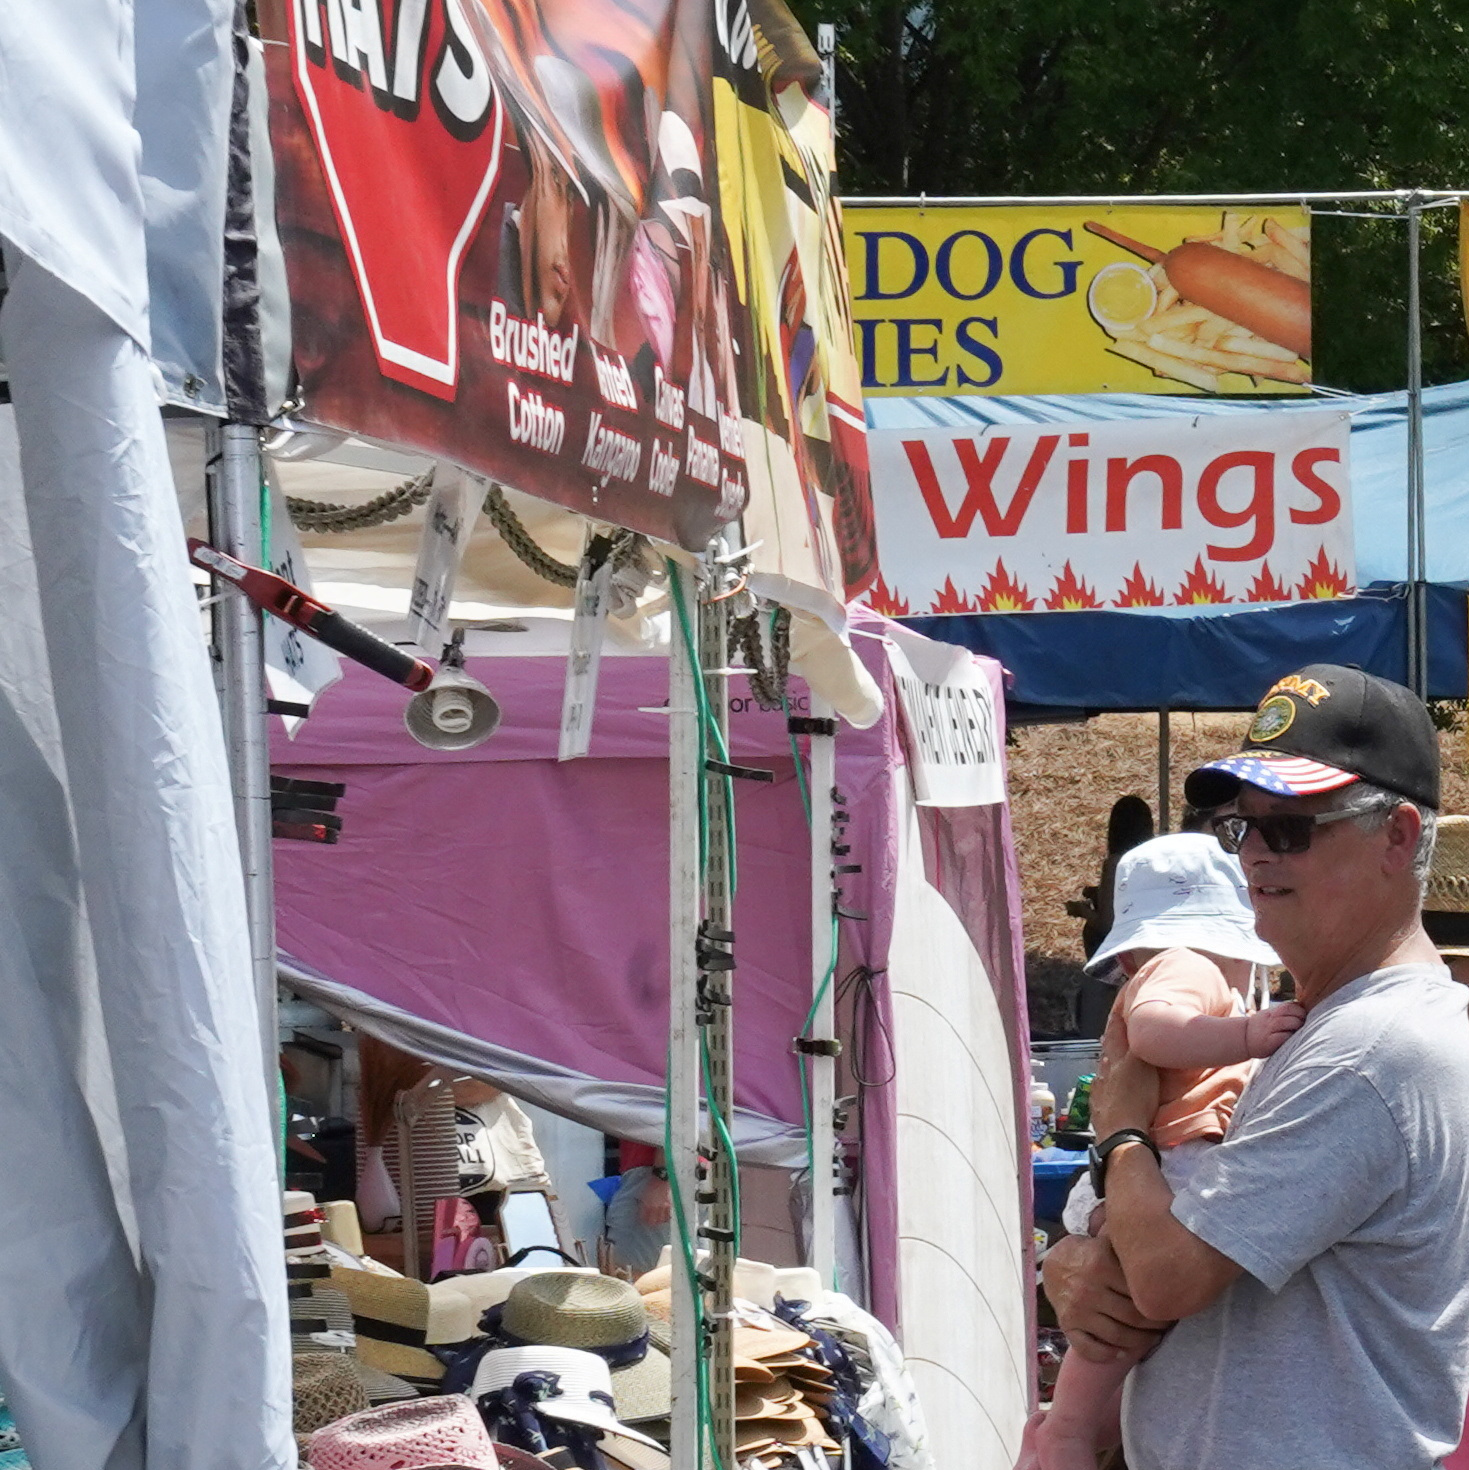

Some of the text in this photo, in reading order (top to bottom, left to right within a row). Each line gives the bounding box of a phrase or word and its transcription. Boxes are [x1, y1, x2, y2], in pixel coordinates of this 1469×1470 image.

[854, 227, 1083, 300] DOG
[490, 299, 578, 383] Brushed
[853, 317, 1003, 388] IES
[508, 381, 565, 455] Cotton
[901, 431, 1342, 562] Wings
